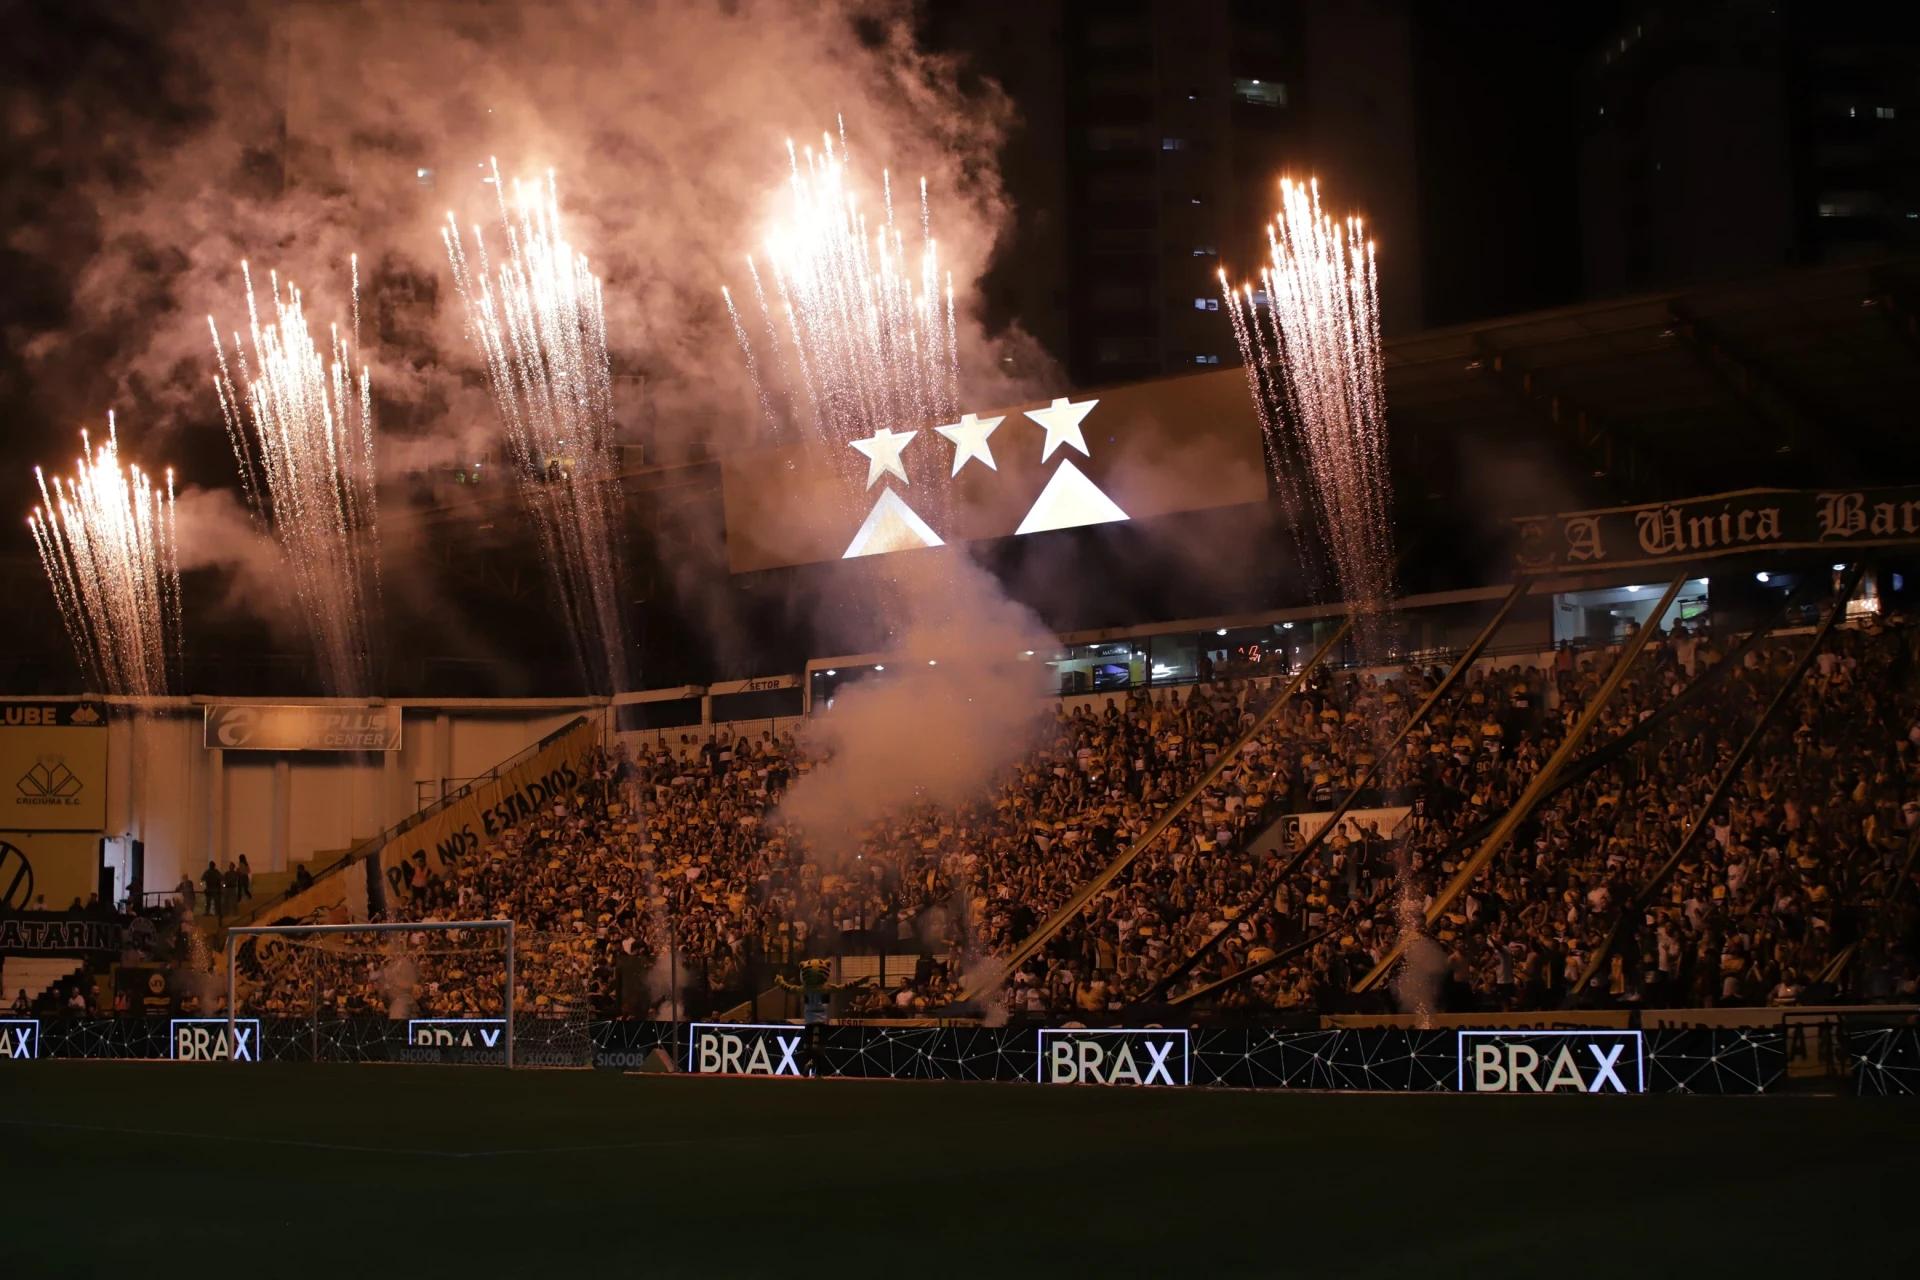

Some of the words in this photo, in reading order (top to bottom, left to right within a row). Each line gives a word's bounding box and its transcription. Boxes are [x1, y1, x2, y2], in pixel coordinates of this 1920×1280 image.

[750, 680, 780, 690] SETOR
[0, 706, 57, 725] UBE
[324, 734, 384, 745] CENTER
[436, 824, 478, 866] NOS
[179, 1027, 251, 1061] BRAX
[596, 1052, 644, 1067] SICOOB
[701, 1034, 801, 1075] BRAX
[1051, 1041, 1174, 1085] BRAX
[1475, 1044, 1627, 1092] BRAX
